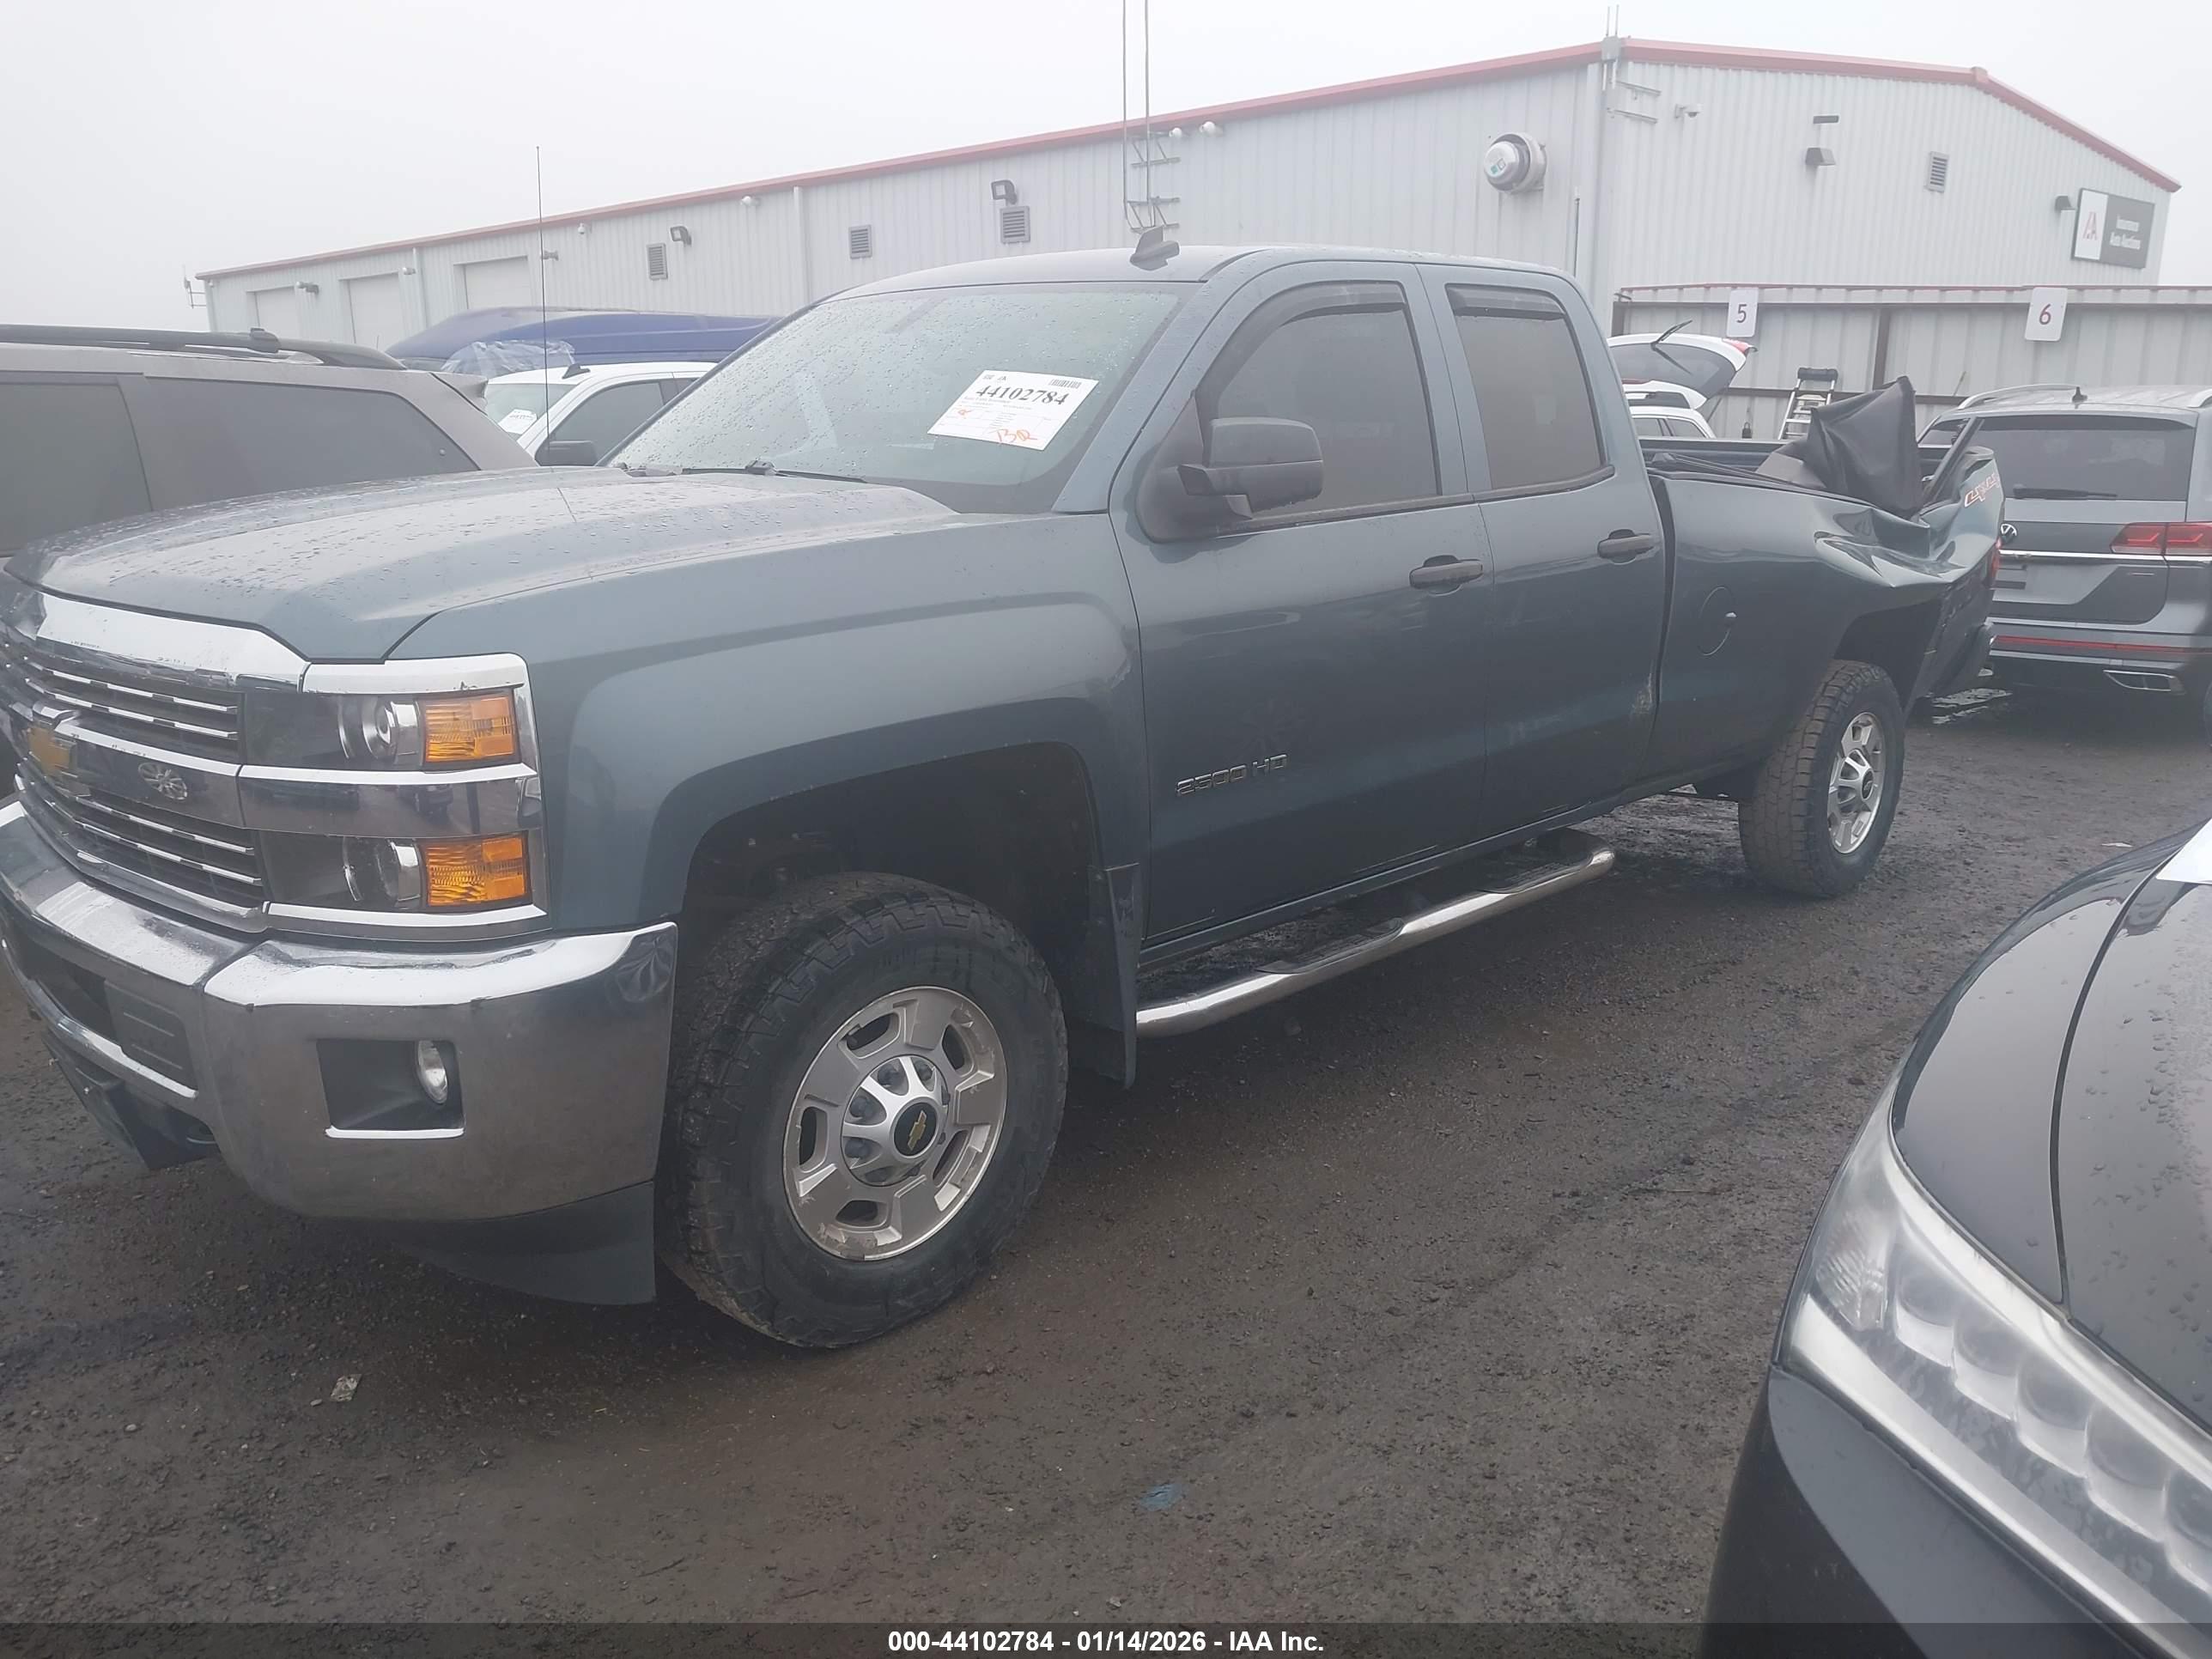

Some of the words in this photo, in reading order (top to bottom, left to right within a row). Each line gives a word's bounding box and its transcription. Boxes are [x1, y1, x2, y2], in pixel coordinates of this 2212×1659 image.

[1736, 303, 1747, 324] 5
[2039, 303, 2052, 325] 6
[976, 385, 1070, 405] 44102784
[1176, 764, 1247, 797] 2500
[1252, 754, 1288, 776] HD
